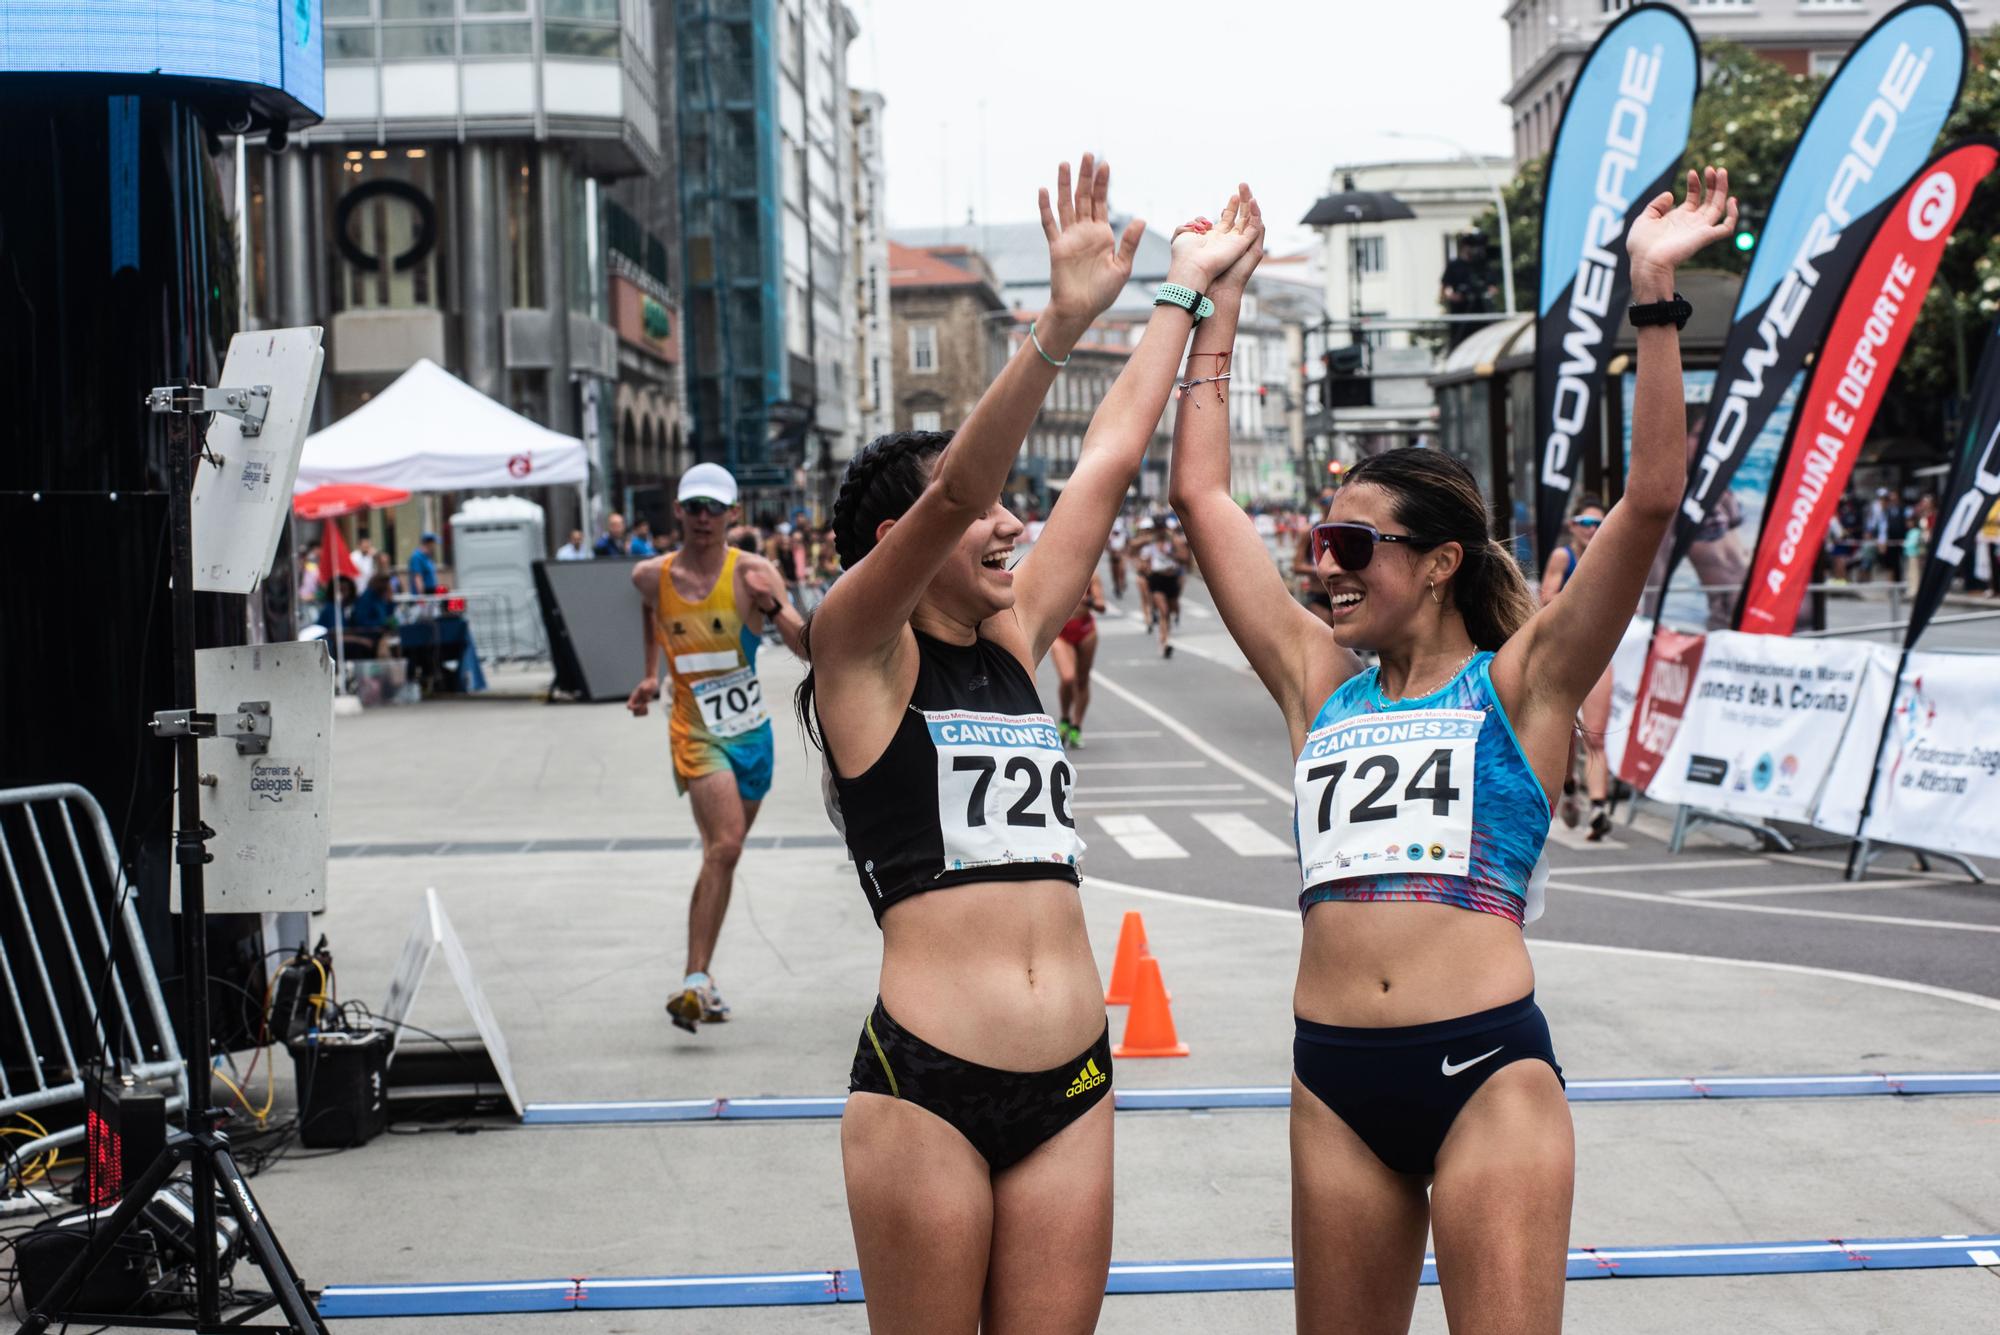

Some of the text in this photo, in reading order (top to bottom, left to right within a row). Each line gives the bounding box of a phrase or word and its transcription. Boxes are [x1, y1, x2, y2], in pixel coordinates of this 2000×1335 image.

[1541, 45, 1662, 492] POWERADE
[1766, 567, 1787, 595] A
[1778, 431, 1845, 566] CORUÑA
[1836, 252, 1917, 410] DEPORTE
[940, 723, 1061, 749] CANTONES
[1311, 720, 1474, 758] CANTONES23
[250, 777, 293, 796] Galegas
[1306, 748, 1460, 834] 724
[1065, 1072, 1106, 1098] adidas
